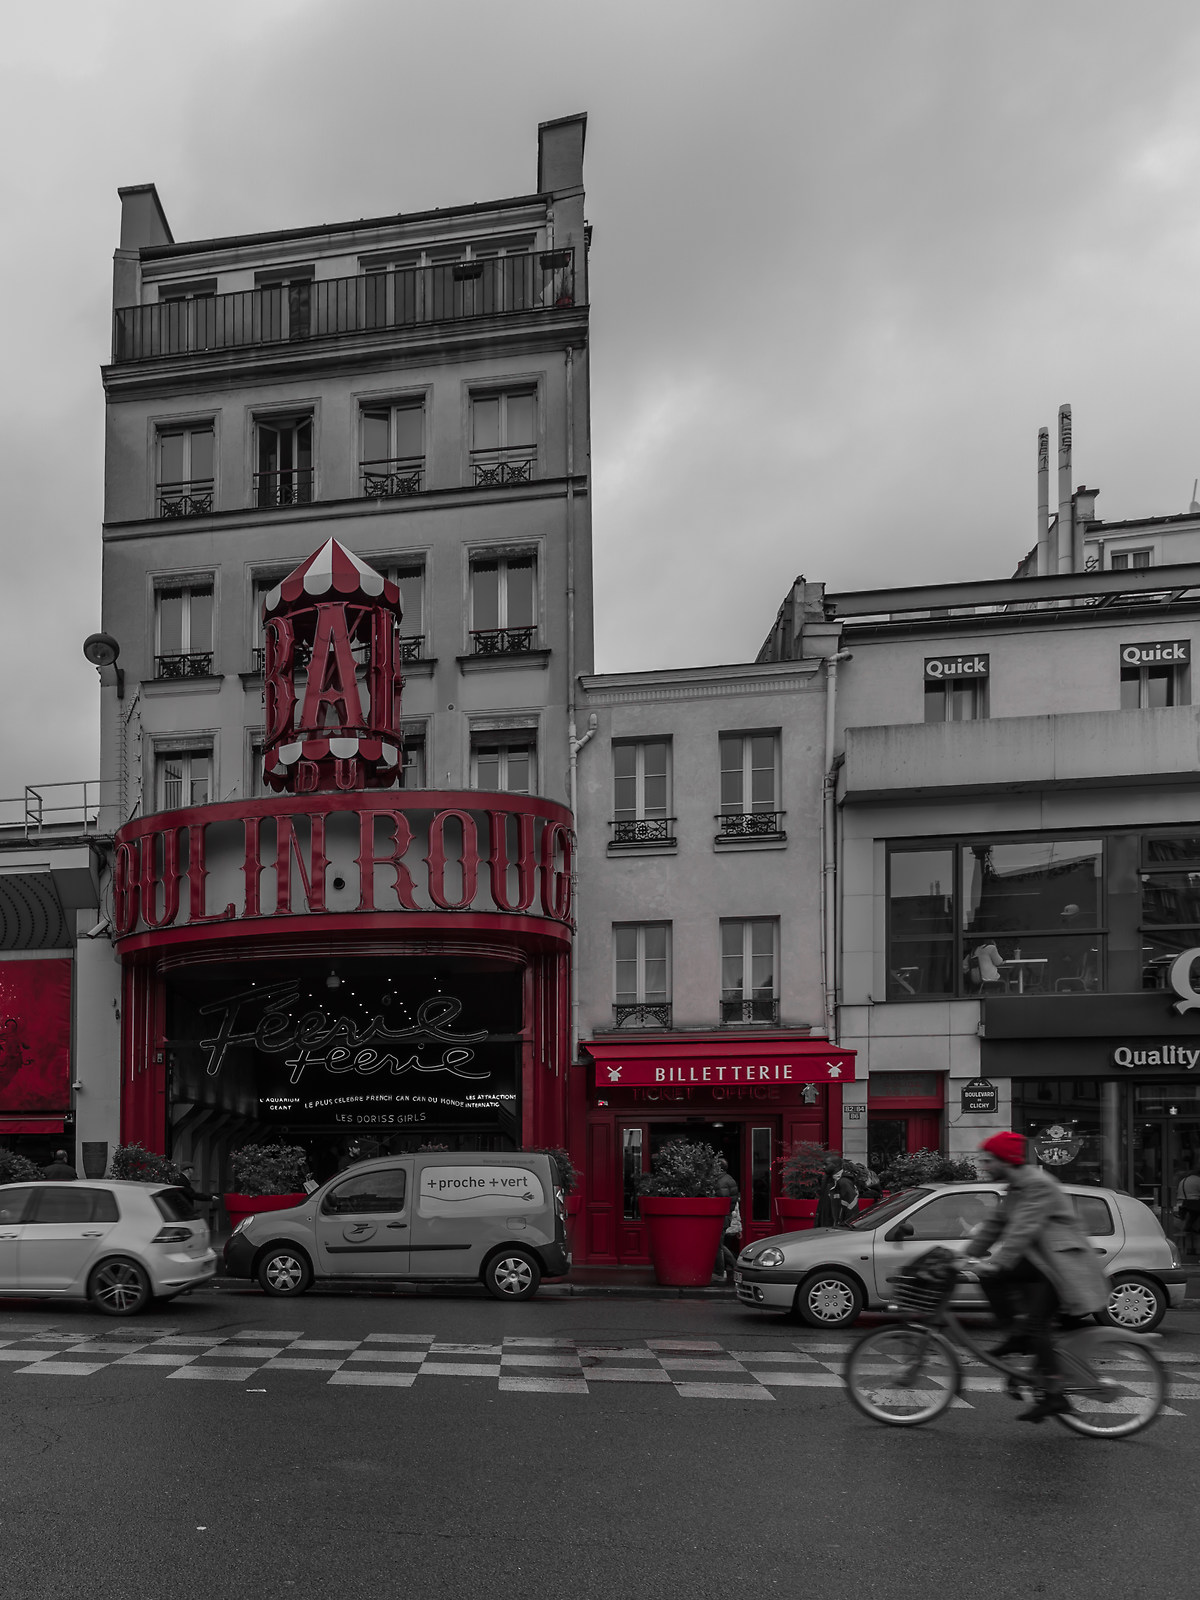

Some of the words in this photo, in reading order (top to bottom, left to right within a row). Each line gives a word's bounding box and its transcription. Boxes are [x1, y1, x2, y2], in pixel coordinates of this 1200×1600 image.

[1123, 643, 1187, 665] Quick
[925, 657, 987, 678] Quick
[298, 759, 358, 792] DU
[113, 811, 333, 936] OULIN
[353, 808, 574, 922] ROUG
[1114, 1045, 1200, 1069] Quality
[655, 1065, 793, 1081] BILLETTERIE
[315, 1099, 333, 1107] PLUS
[412, 1095, 426, 1103] CAN
[633, 1087, 694, 1101] TICKET
[711, 1085, 780, 1100] OFFICE
[335, 1113, 353, 1123] LES
[356, 1114, 395, 1124] DORISS
[396, 1112, 427, 1124] GIRLS
